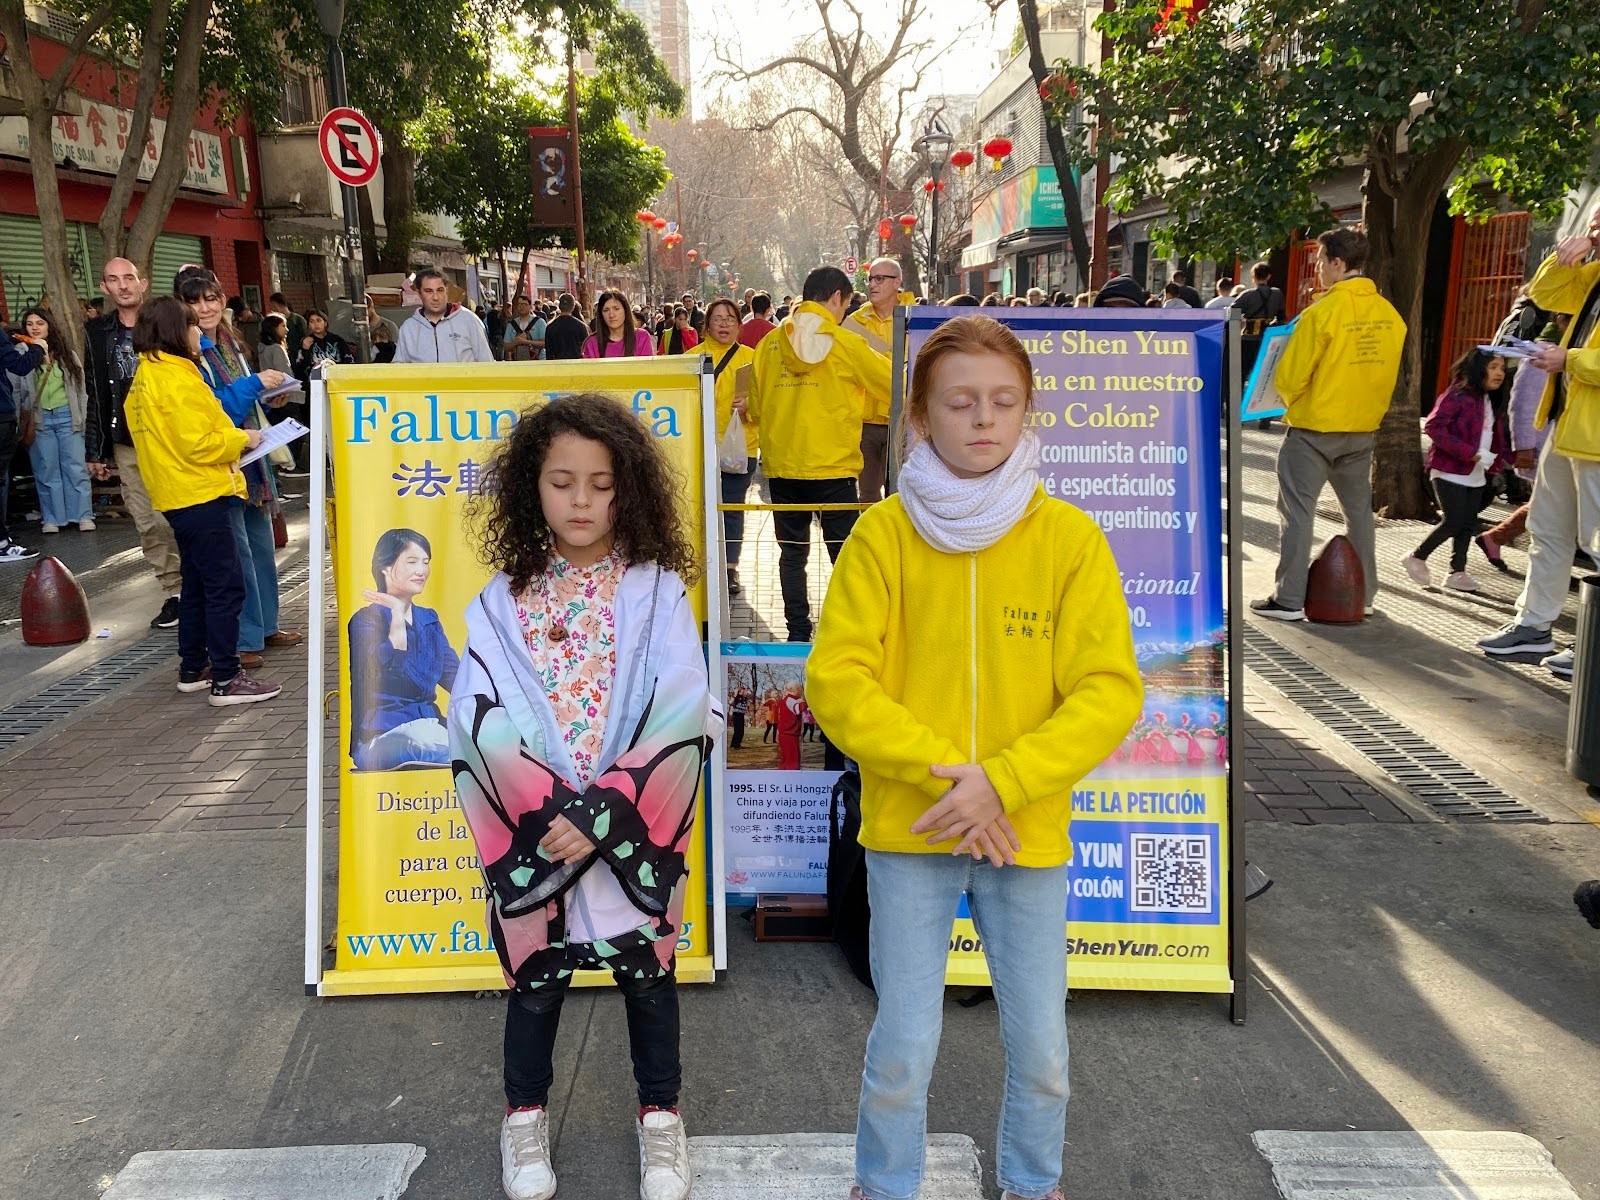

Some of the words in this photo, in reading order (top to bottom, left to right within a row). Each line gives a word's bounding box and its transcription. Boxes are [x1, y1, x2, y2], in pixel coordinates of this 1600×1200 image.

[65, 145, 76, 159] DE
[77, 147, 96, 163] SOJA
[337, 124, 366, 168] E
[1061, 329, 1128, 355] Shen
[1133, 330, 1189, 355] Yun
[1064, 375, 1097, 391] en
[1103, 372, 1204, 393] nuestro
[346, 394, 520, 444] Falun
[1064, 402, 1160, 428] Colón?
[1041, 440, 1135, 464] comunista
[1139, 440, 1188, 464] chino
[1060, 472, 1176, 500] espectáculos
[1185, 511, 1198, 534] y
[1003, 606, 1037, 621] Falun
[729, 784, 756, 793] 1995.
[758, 784, 767, 793] El
[769, 784, 782, 793] Sr.
[784, 784, 793, 793] Li
[736, 797, 764, 807] China
[766, 799, 773, 808] y
[775, 797, 798, 808] viaja
[800, 799, 817, 808] por
[819, 798, 828, 807] el
[1071, 790, 1095, 812] ME
[1100, 791, 1122, 813] LA
[1127, 788, 1206, 815] PETICIÓN
[743, 810, 802, 820] difundiendo
[416, 820, 441, 840] de
[448, 819, 468, 840] la
[752, 834, 831, 844] 全世界傳播法輪
[399, 855, 449, 877] para
[1078, 841, 1123, 869] YUN
[385, 886, 463, 906] cuerpo,
[1073, 875, 1124, 899] COLÓN
